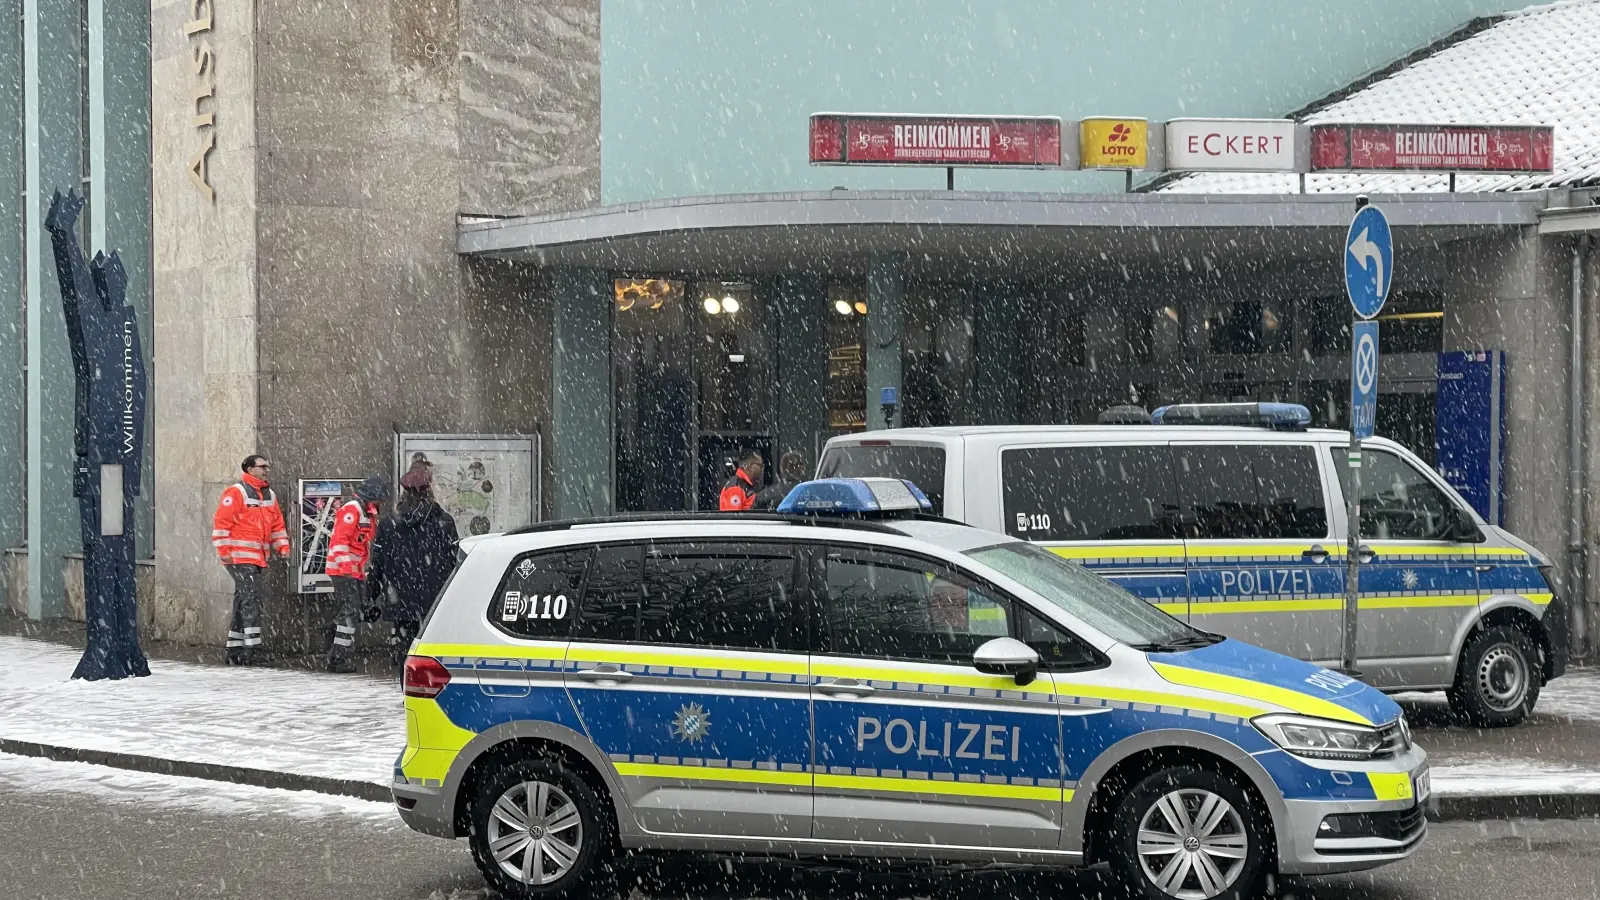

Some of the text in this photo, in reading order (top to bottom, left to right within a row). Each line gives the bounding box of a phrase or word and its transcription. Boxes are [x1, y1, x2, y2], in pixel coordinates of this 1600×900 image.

[894, 125, 990, 148] REINKOMMEN
[1188, 133, 1283, 156] ECKERT
[1395, 132, 1487, 155] REINKOMMEN
[1102, 145, 1136, 156] LOTTO
[124, 320, 134, 454] Willkommen
[1441, 372, 1464, 380] Ansbach
[1354, 402, 1374, 429] TAXI
[1030, 513, 1051, 530] 110
[1220, 570, 1313, 595] POLIZEI
[527, 594, 568, 620] 110
[857, 716, 1021, 762] POLIZEI
